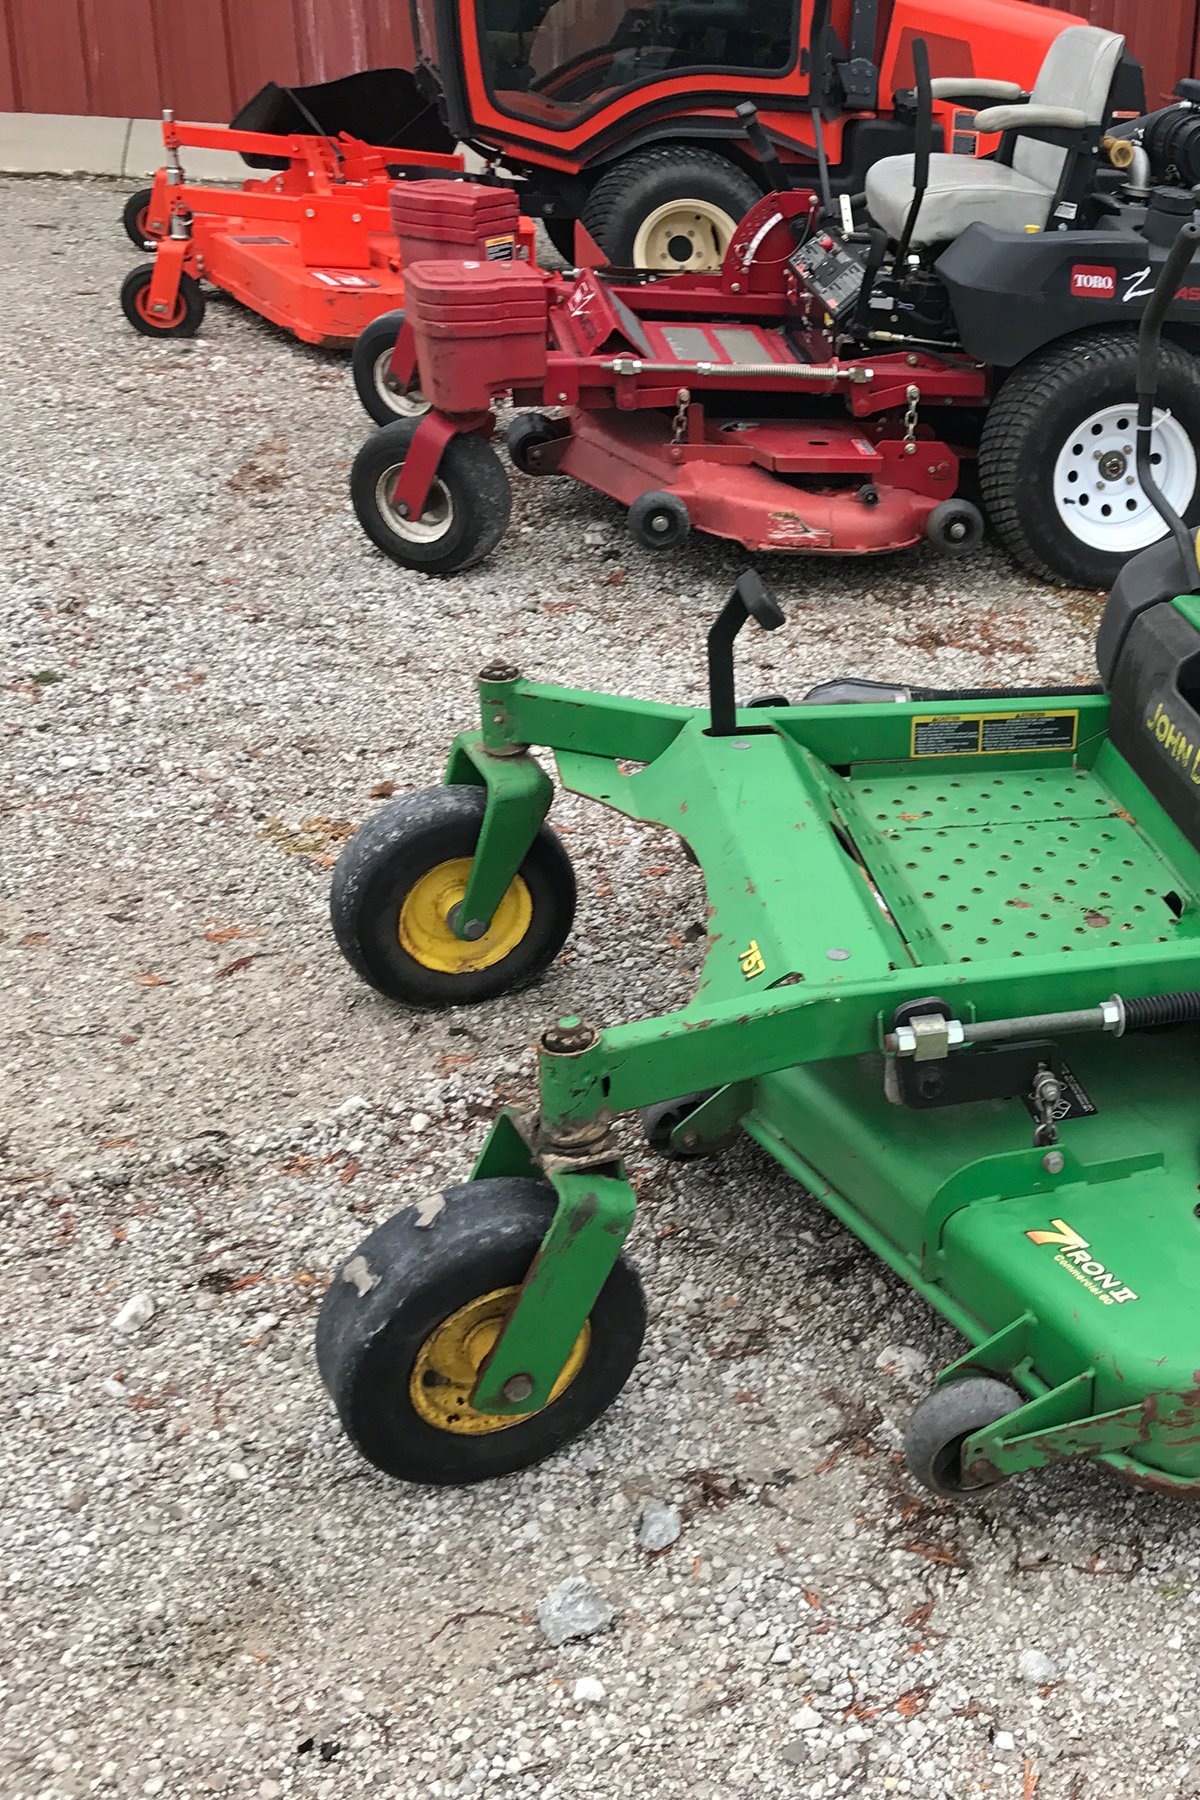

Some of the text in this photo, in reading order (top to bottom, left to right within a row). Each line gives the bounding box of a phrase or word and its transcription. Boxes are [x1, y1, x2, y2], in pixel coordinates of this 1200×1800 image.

[1073, 274, 1114, 290] TORO
[1146, 702, 1194, 768] JOHN
[738, 939, 766, 981] 757
[1053, 1254, 1103, 1295] Commercial
